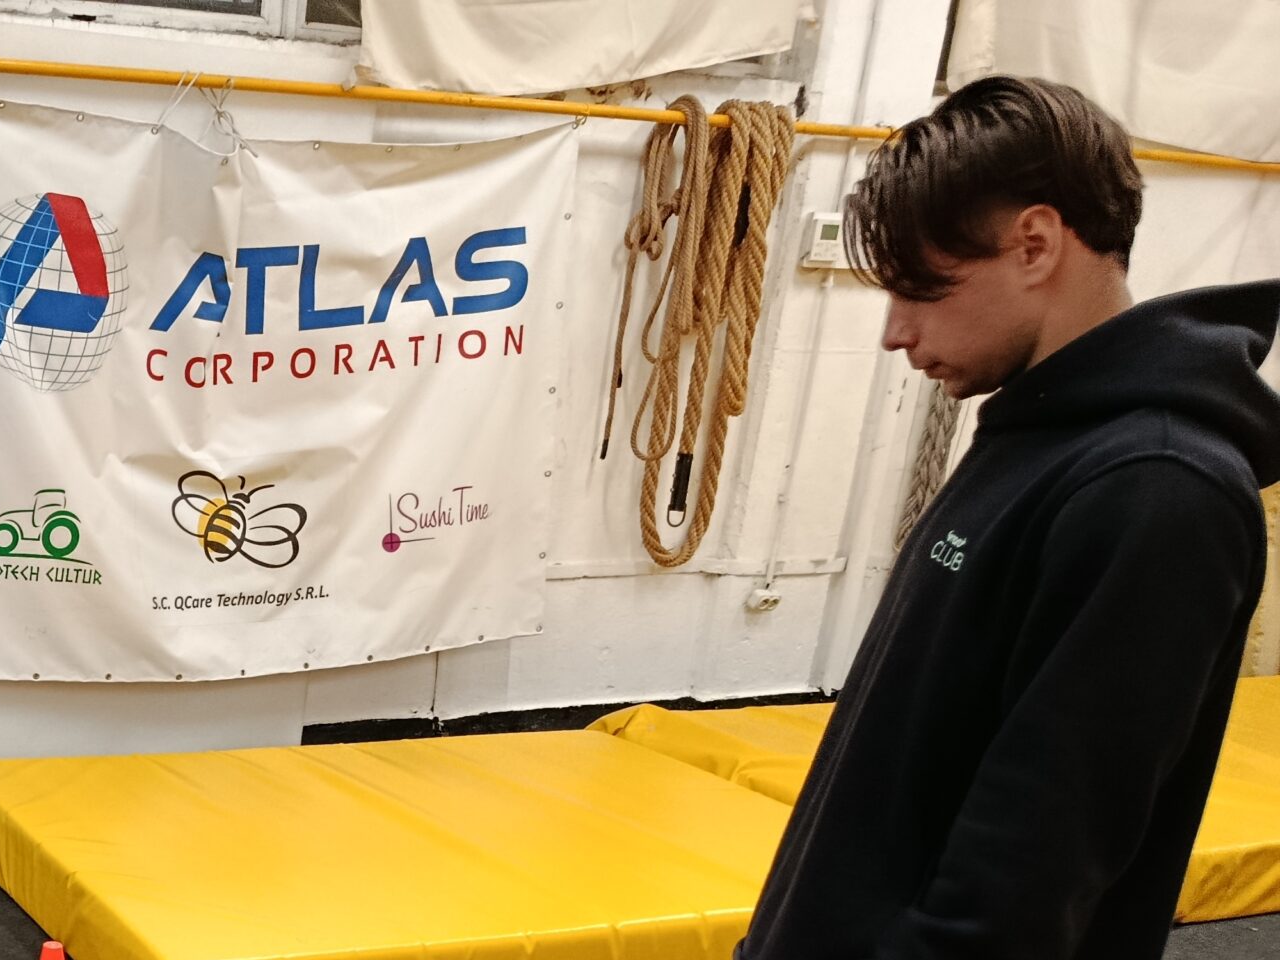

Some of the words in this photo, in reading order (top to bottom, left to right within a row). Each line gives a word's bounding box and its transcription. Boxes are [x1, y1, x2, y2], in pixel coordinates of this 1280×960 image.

[149, 226, 529, 335] ATLAS
[146, 324, 525, 388] CORPORATION
[396, 492, 454, 533] Sushi
[452, 485, 490, 525] Time
[930, 540, 964, 571] CLUB
[46, 566, 103, 585] CULTUR
[152, 596, 171, 610] S.C.
[174, 595, 212, 611] QCare
[216, 590, 292, 607] Technology
[293, 585, 330, 602] S.R.L.
